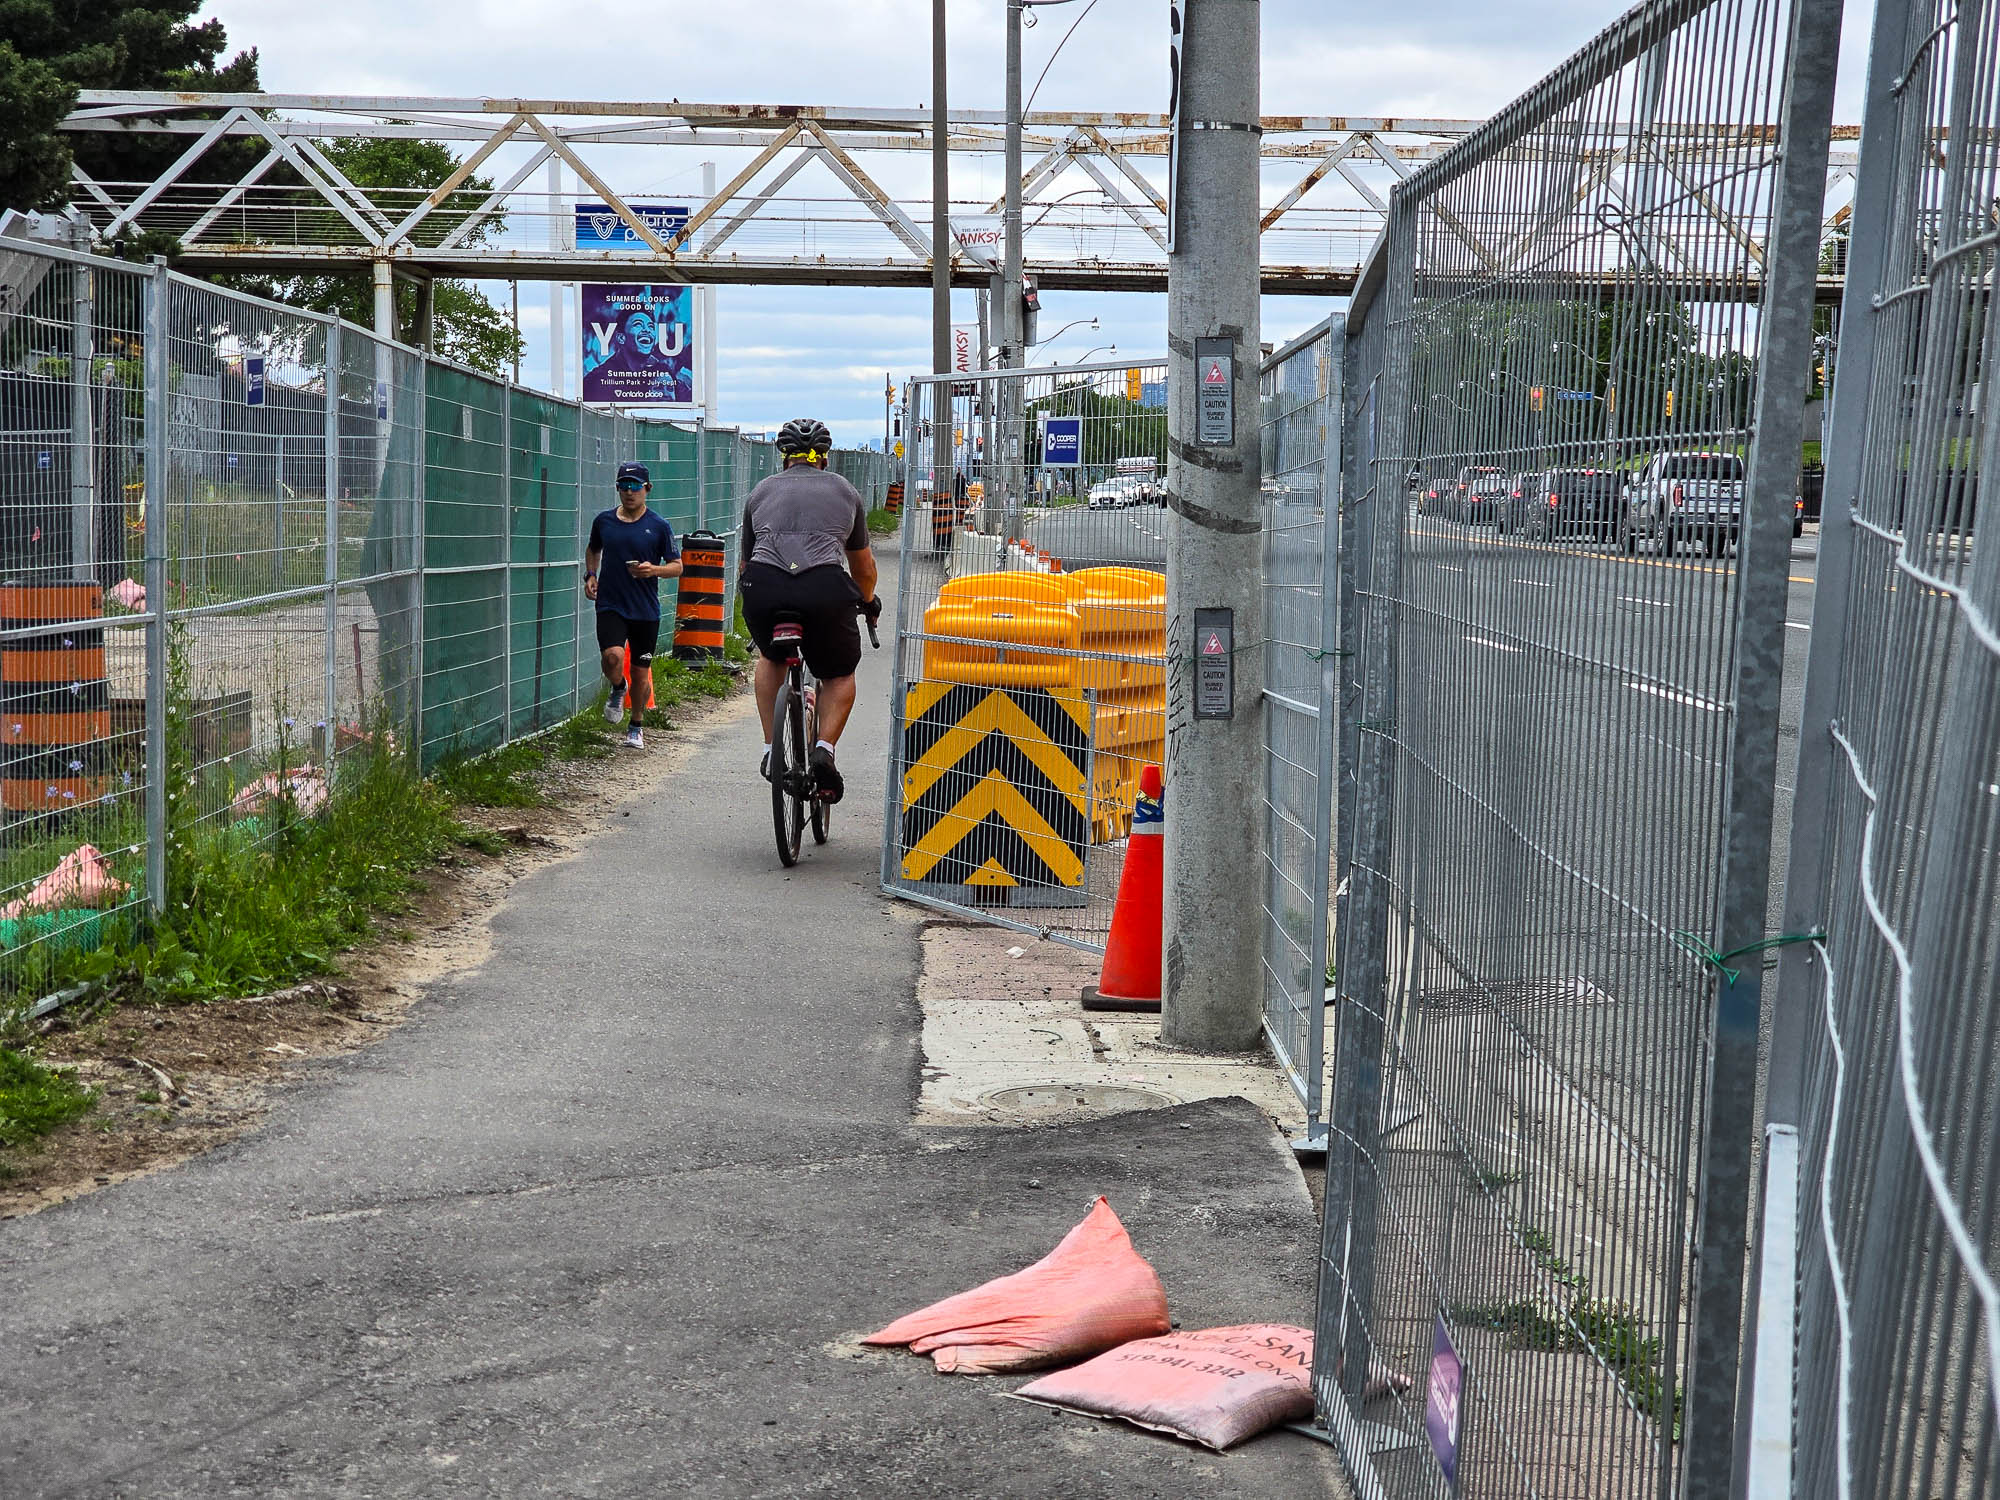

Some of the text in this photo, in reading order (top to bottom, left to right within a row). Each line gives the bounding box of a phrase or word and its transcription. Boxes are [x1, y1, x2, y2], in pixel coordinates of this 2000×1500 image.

[955, 232, 1001, 247] ANKSY
[606, 295, 641, 303] SUMMER
[621, 390, 664, 398] ontario place
[1056, 434, 1077, 442] COOPER
[1115, 1353, 1246, 1380] 519-941-3242
[1255, 1360, 1301, 1382] ONT
